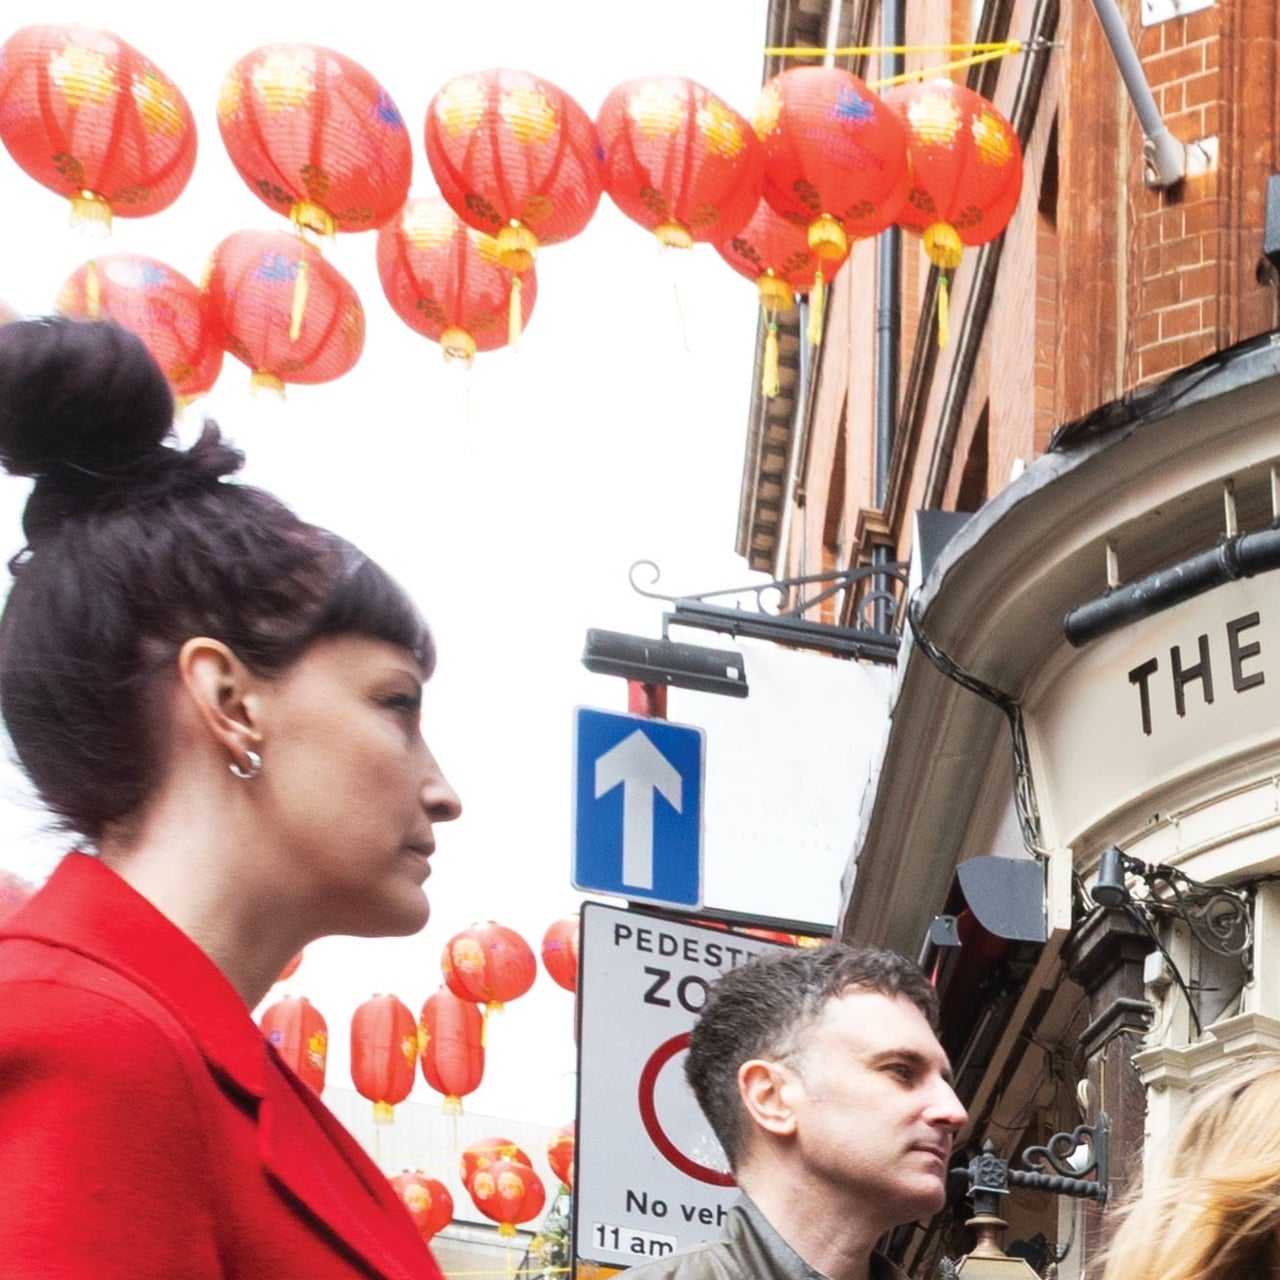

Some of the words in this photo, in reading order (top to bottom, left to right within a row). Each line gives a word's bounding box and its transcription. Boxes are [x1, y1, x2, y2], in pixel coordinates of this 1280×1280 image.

[1128, 611, 1266, 735] THE
[613, 923, 760, 968] PEDEST
[643, 965, 711, 1014] ZO
[626, 1189, 669, 1219] No
[680, 1203, 729, 1227] veh
